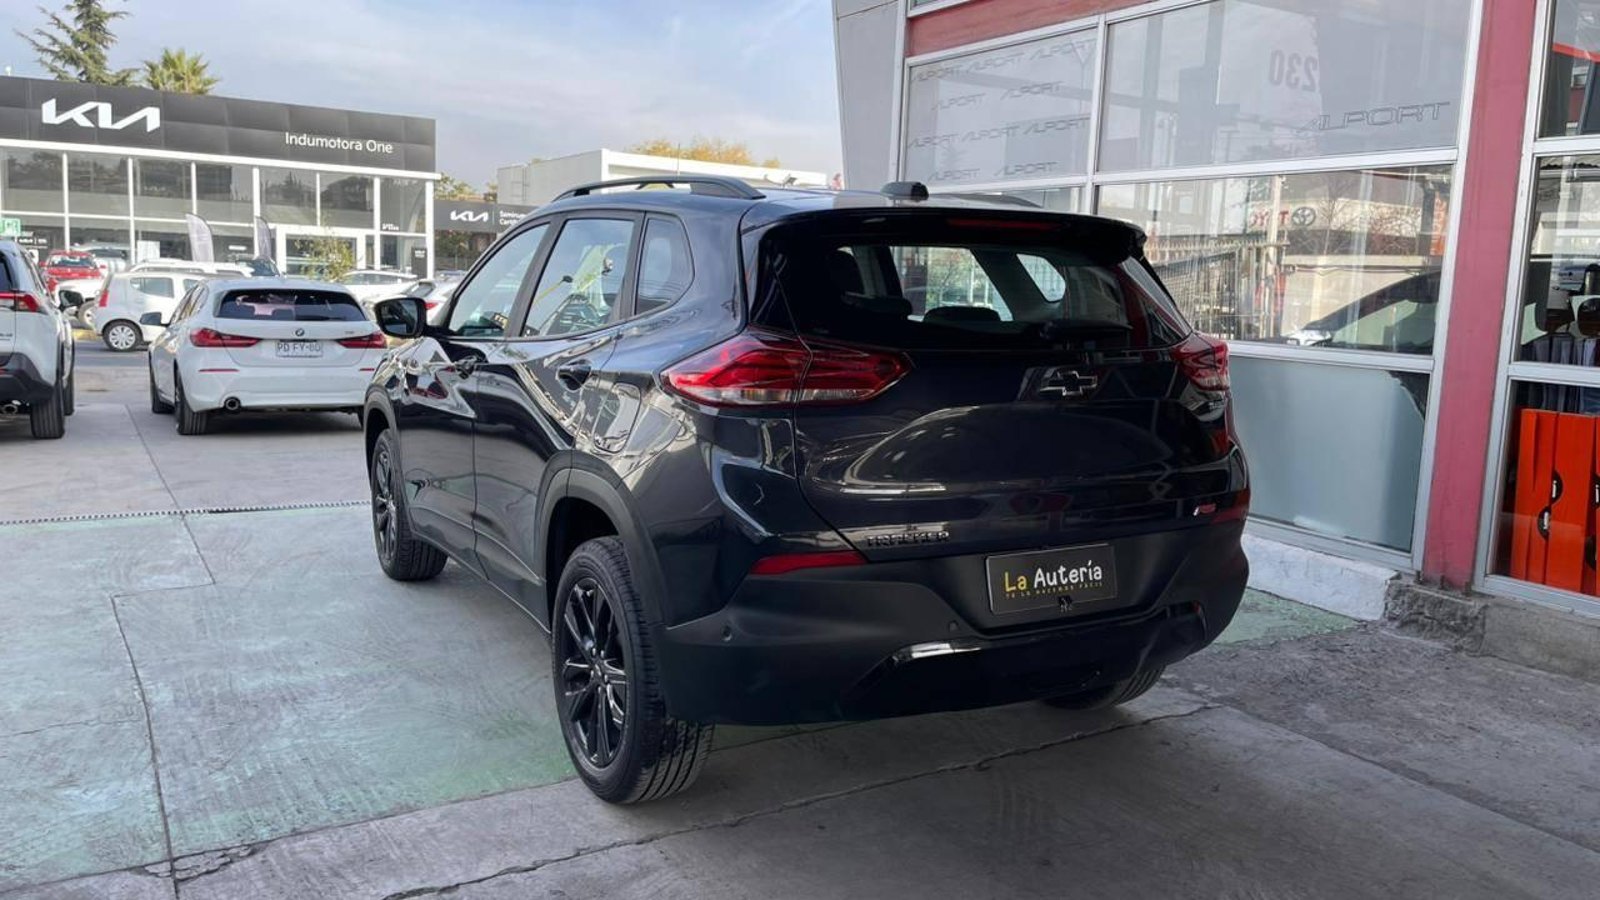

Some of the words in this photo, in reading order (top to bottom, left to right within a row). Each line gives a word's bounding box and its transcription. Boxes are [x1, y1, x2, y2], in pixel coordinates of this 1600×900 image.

[42, 98, 161, 132] KIA
[285, 132, 363, 151] Indumotora
[366, 140, 394, 153] One
[1004, 572, 1027, 592] La
[1034, 560, 1102, 588] Autería
